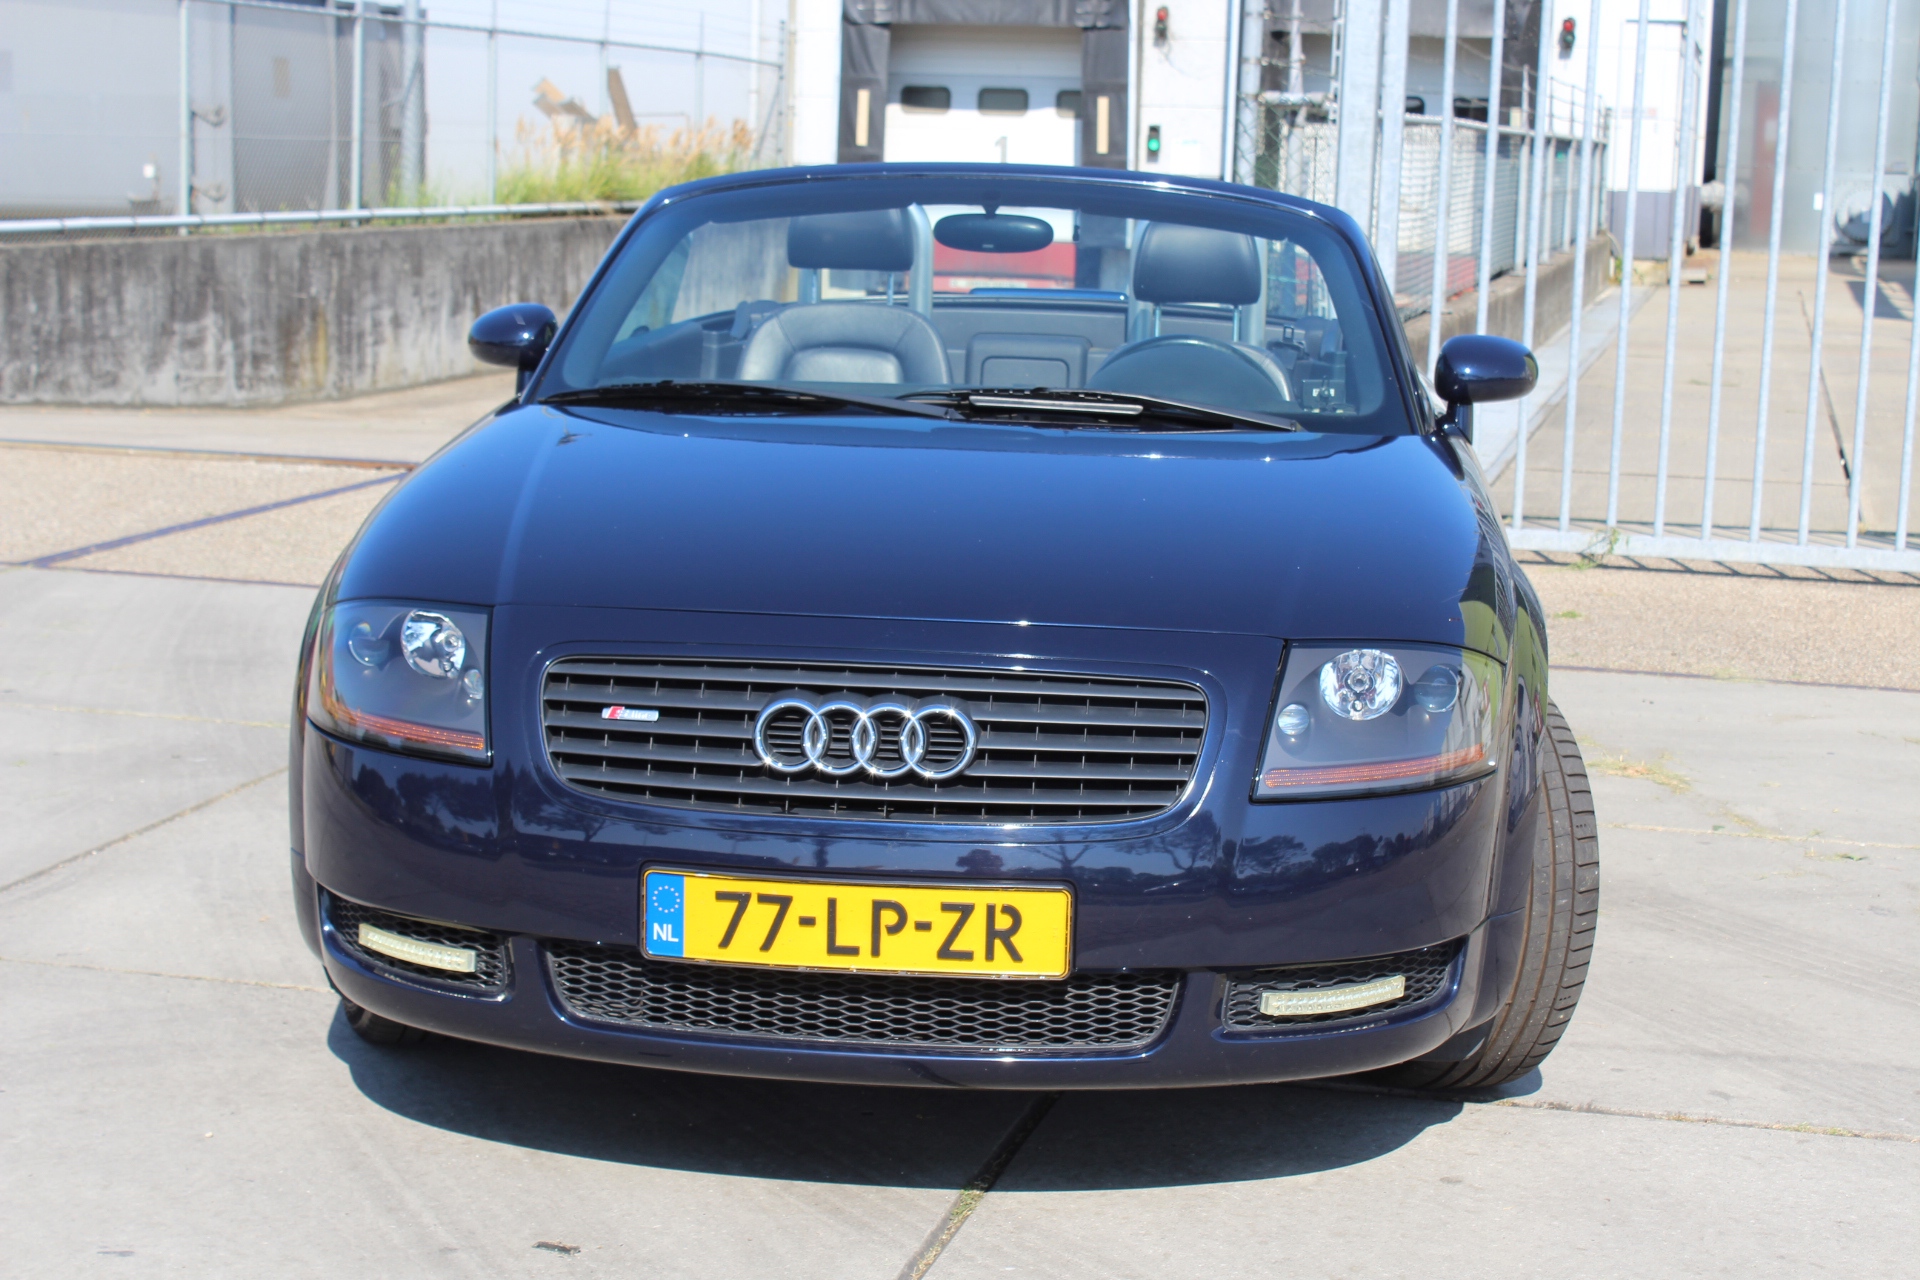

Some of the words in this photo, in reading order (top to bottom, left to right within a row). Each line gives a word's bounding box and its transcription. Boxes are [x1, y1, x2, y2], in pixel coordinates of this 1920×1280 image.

[994, 136, 1008, 163] 1
[653, 922, 679, 942] NL
[715, 891, 1023, 962] 77-LP-ZR
